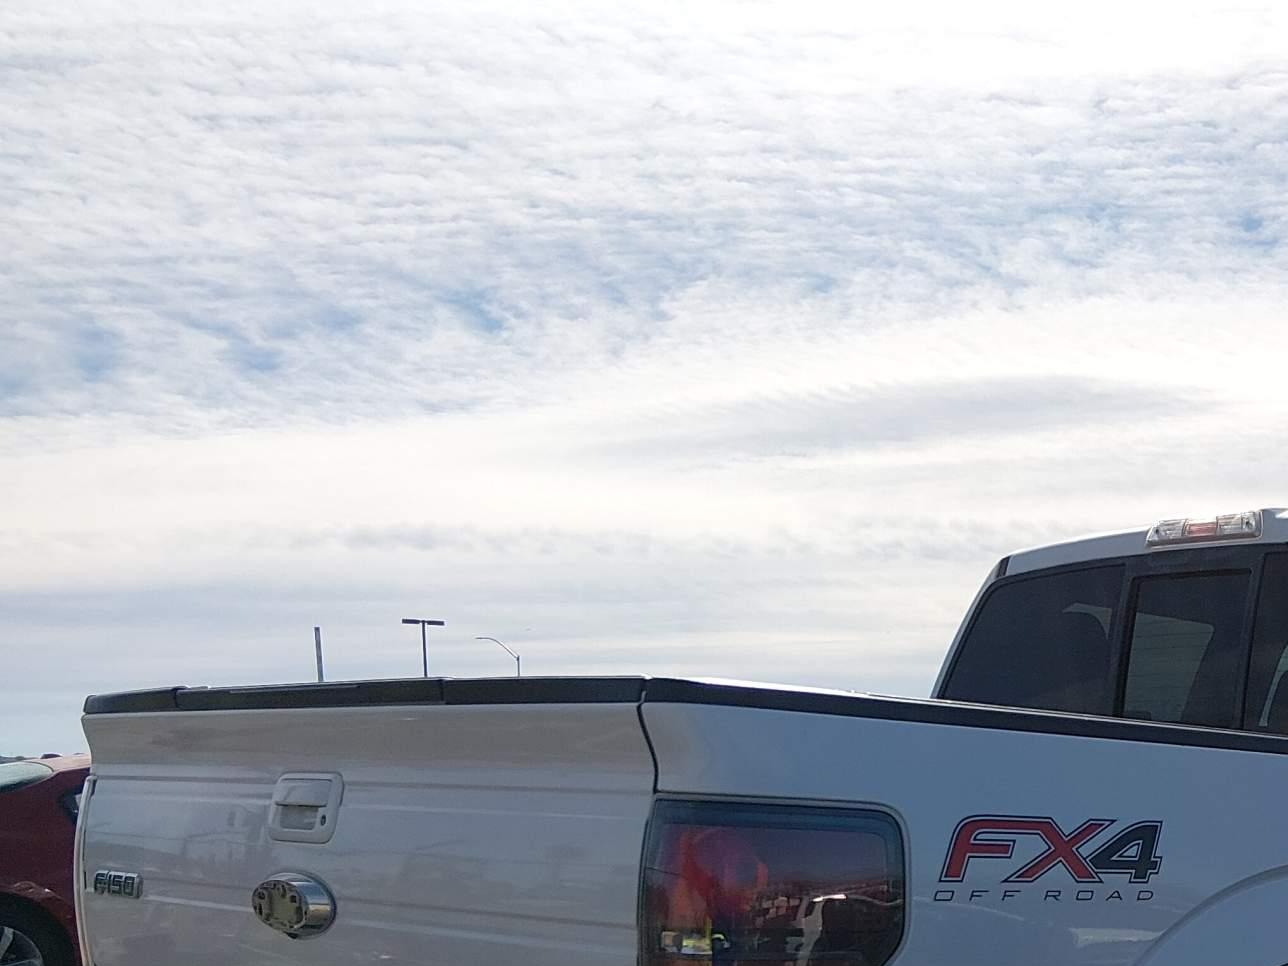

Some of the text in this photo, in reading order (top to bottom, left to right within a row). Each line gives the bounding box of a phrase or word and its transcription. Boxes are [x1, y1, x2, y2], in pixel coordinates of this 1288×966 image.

[938, 814, 1164, 883] FX4
[933, 890, 1155, 902] OFF ROAD
